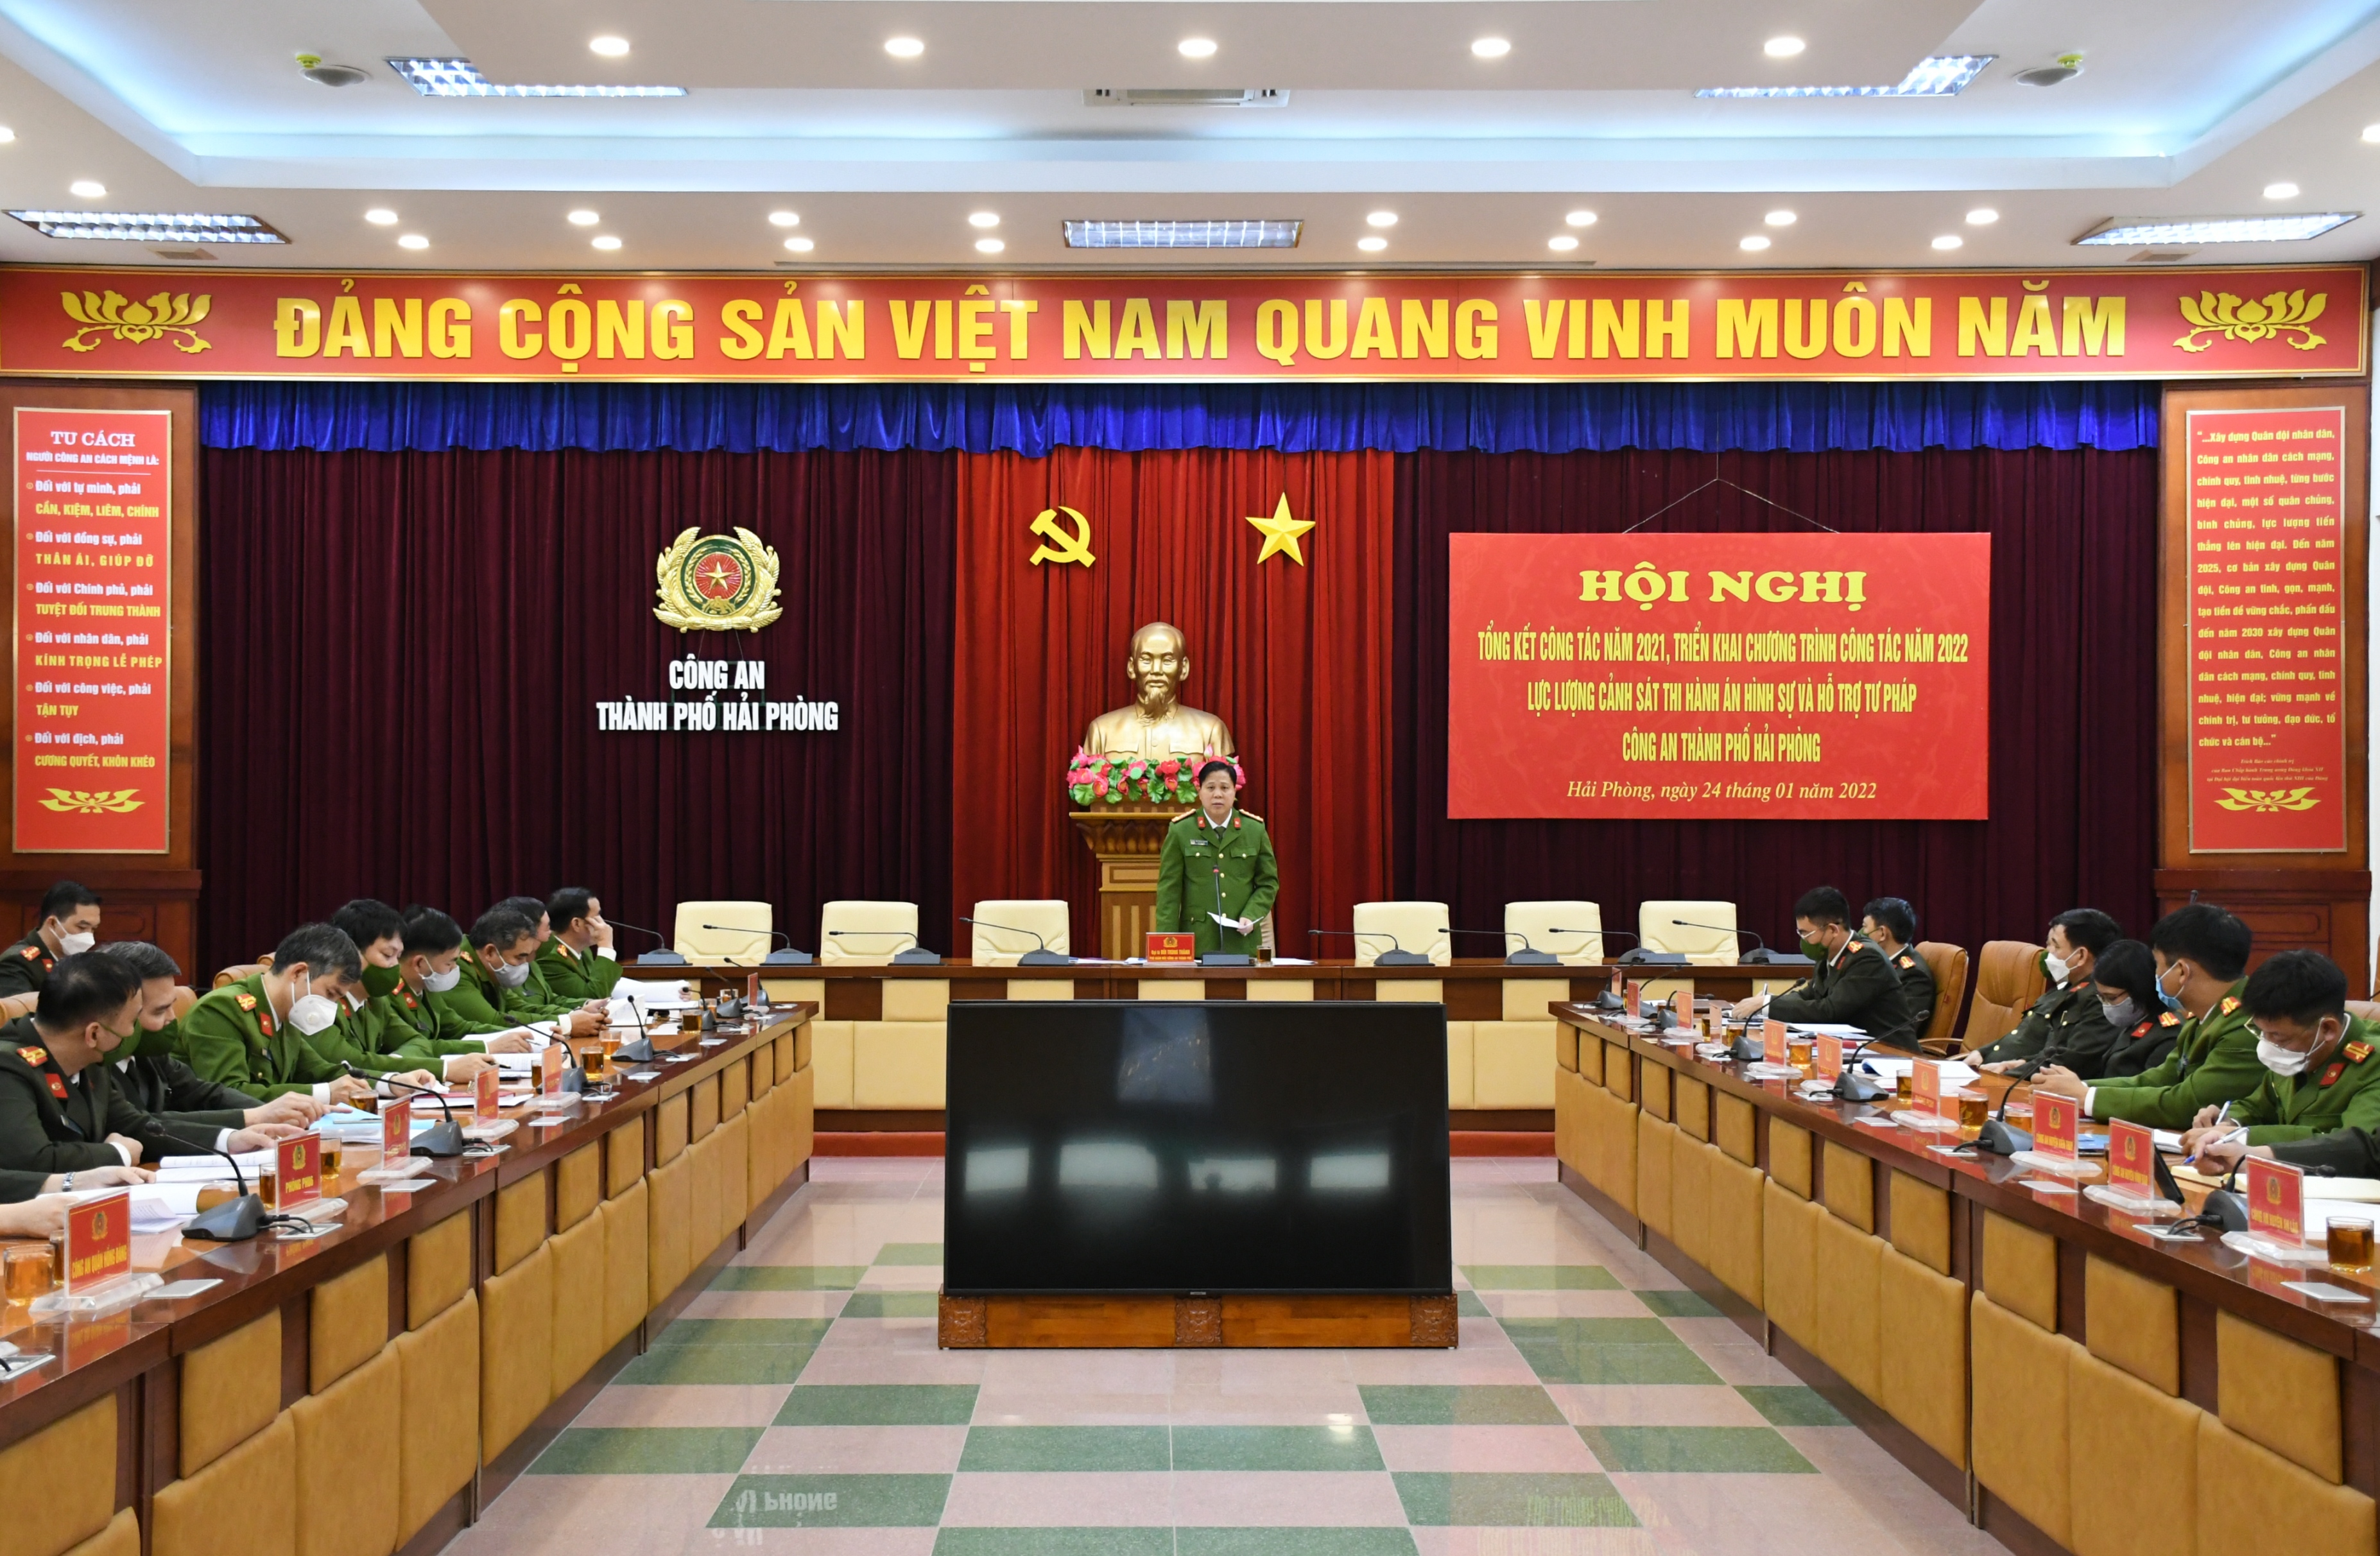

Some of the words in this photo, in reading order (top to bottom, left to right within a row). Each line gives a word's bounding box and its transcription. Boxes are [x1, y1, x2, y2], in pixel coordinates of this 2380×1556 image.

[275, 279, 471, 358] ĐẢNG
[500, 284, 694, 372] CỘNG
[721, 281, 865, 359] SẢN
[890, 286, 1037, 372] VIỆT
[1064, 300, 1227, 359] NAM
[1257, 298, 1497, 365] QUANG
[1525, 300, 1689, 358] VINH
[1716, 282, 1931, 358] MUÔN
[1958, 282, 2125, 356] NĂM
[82, 429, 136, 447] CÁCH
[55, 451, 79, 463] CÔNG
[80, 454, 93, 463] AN
[94, 453, 118, 464] CÁCH
[2197, 454, 2220, 465] Công
[2223, 455, 2234, 464] an
[2238, 453, 2259, 463] nhân
[2262, 452, 2279, 463] dân
[2282, 452, 2304, 462] cách
[2307, 452, 2334, 463] mạng,
[35, 479, 53, 492] Đối
[56, 481, 72, 492] với
[74, 481, 85, 496] tự
[118, 481, 141, 496] phải
[64, 502, 94, 518] KIỆM,
[96, 503, 125, 518] LIÊM,
[127, 504, 160, 518] CHÍNH
[36, 551, 71, 566] THÂN
[99, 553, 132, 567] GIÚP
[2198, 563, 2221, 573] 2025,
[2227, 564, 2238, 573] cơ
[2243, 561, 2259, 572] bản
[2265, 562, 2281, 573] xây
[2286, 561, 2307, 573] dựng
[2313, 560, 2335, 571] Quân
[36, 581, 53, 594] Đối
[56, 582, 72, 594] với
[74, 583, 104, 595] Chính
[131, 583, 153, 597] phải
[1579, 561, 1689, 610] HỘI
[1709, 571, 1867, 611] NGHỊ
[36, 601, 67, 618] TUYỆT
[69, 601, 87, 616] ĐỐI
[90, 605, 125, 617] TRUNG
[126, 603, 161, 618] THÀNH
[35, 630, 53, 643] Đối
[55, 632, 71, 644] với
[74, 633, 99, 644] nhân
[101, 633, 124, 646] dân,
[126, 632, 149, 646] phải
[2198, 627, 2215, 638] đến
[2219, 628, 2238, 638] năm
[2242, 627, 2264, 637] 2030
[2268, 627, 2283, 637] xây
[2288, 627, 2309, 638] dựng
[2314, 626, 2336, 637] Quân
[1478, 620, 1510, 660] TỔNG
[1514, 623, 1536, 660] KẾT
[1540, 626, 1573, 661] CÔNG
[1577, 627, 1600, 661] TÁC
[1605, 627, 1632, 661] NĂM
[1637, 633, 1669, 664] 2021,
[1674, 621, 1709, 661] TRIỂN
[1713, 634, 1741, 661] KHAI
[1746, 630, 1796, 662] CHƯƠNG
[1800, 627, 1836, 662] TRÌNH
[1840, 627, 1874, 662] CÔNG
[1878, 627, 1901, 662] TÁC
[1905, 628, 1934, 662] NĂM
[1938, 634, 1968, 662] 2022
[36, 653, 65, 666] KÍNH
[69, 655, 110, 669] TRỌNG
[131, 655, 163, 668] PHÉP
[669, 653, 728, 689] CÔNG
[734, 661, 764, 689] AN
[2198, 671, 2215, 682] dân
[2218, 671, 2239, 682] cách
[2241, 672, 2268, 682] mạng,
[2272, 670, 2296, 680] chính
[2298, 672, 2316, 681] quy,
[35, 680, 53, 693] Đối
[55, 682, 71, 693] với
[74, 682, 99, 695] công
[101, 682, 126, 696] việc,
[128, 682, 151, 696] phải
[1528, 679, 1551, 716] LỰC
[1555, 679, 1594, 717] LƯỢNG
[1599, 673, 1632, 711] CẢNH
[1636, 677, 1659, 711] SÁT
[1663, 683, 1681, 711] THI
[1686, 677, 1719, 711] HÀNH
[1723, 677, 1740, 711] ÁN
[1745, 677, 1773, 711] HÌNH
[1778, 680, 1796, 718] SỰ
[1798, 677, 1813, 711] VÀ
[1818, 673, 1834, 712] HỖ
[1838, 681, 1861, 718] TRỢ
[1865, 680, 1881, 712] TƯ
[1884, 677, 1917, 712] PHÁP
[37, 702, 58, 718] TẬN
[60, 704, 79, 718] TỤY
[596, 695, 667, 730] THÀNH
[674, 691, 717, 730] PHỐ
[723, 692, 759, 730] HẢI
[766, 695, 838, 730] PHÒNG
[35, 731, 52, 744] Đối
[55, 732, 71, 744] với
[101, 732, 124, 746] phải
[1623, 727, 1656, 761] CÔNG
[1660, 733, 1677, 761] AN
[1681, 727, 1721, 761] THÀNH
[1725, 723, 1750, 761] PHỐ
[1754, 723, 1774, 761] HẢI
[1779, 726, 1820, 762] PHÒNG
[102, 754, 129, 768] KHÔN
[130, 754, 155, 768] KHÉO
[1567, 781, 1596, 797] Hải
[1601, 781, 1655, 801] Phòng,
[1661, 782, 1697, 801] ngày
[1702, 782, 1721, 797] 24
[1726, 782, 1771, 802] tháng
[1776, 782, 1793, 798] 01
[1800, 783, 1833, 798] năm
[1839, 782, 1876, 798] 2022
